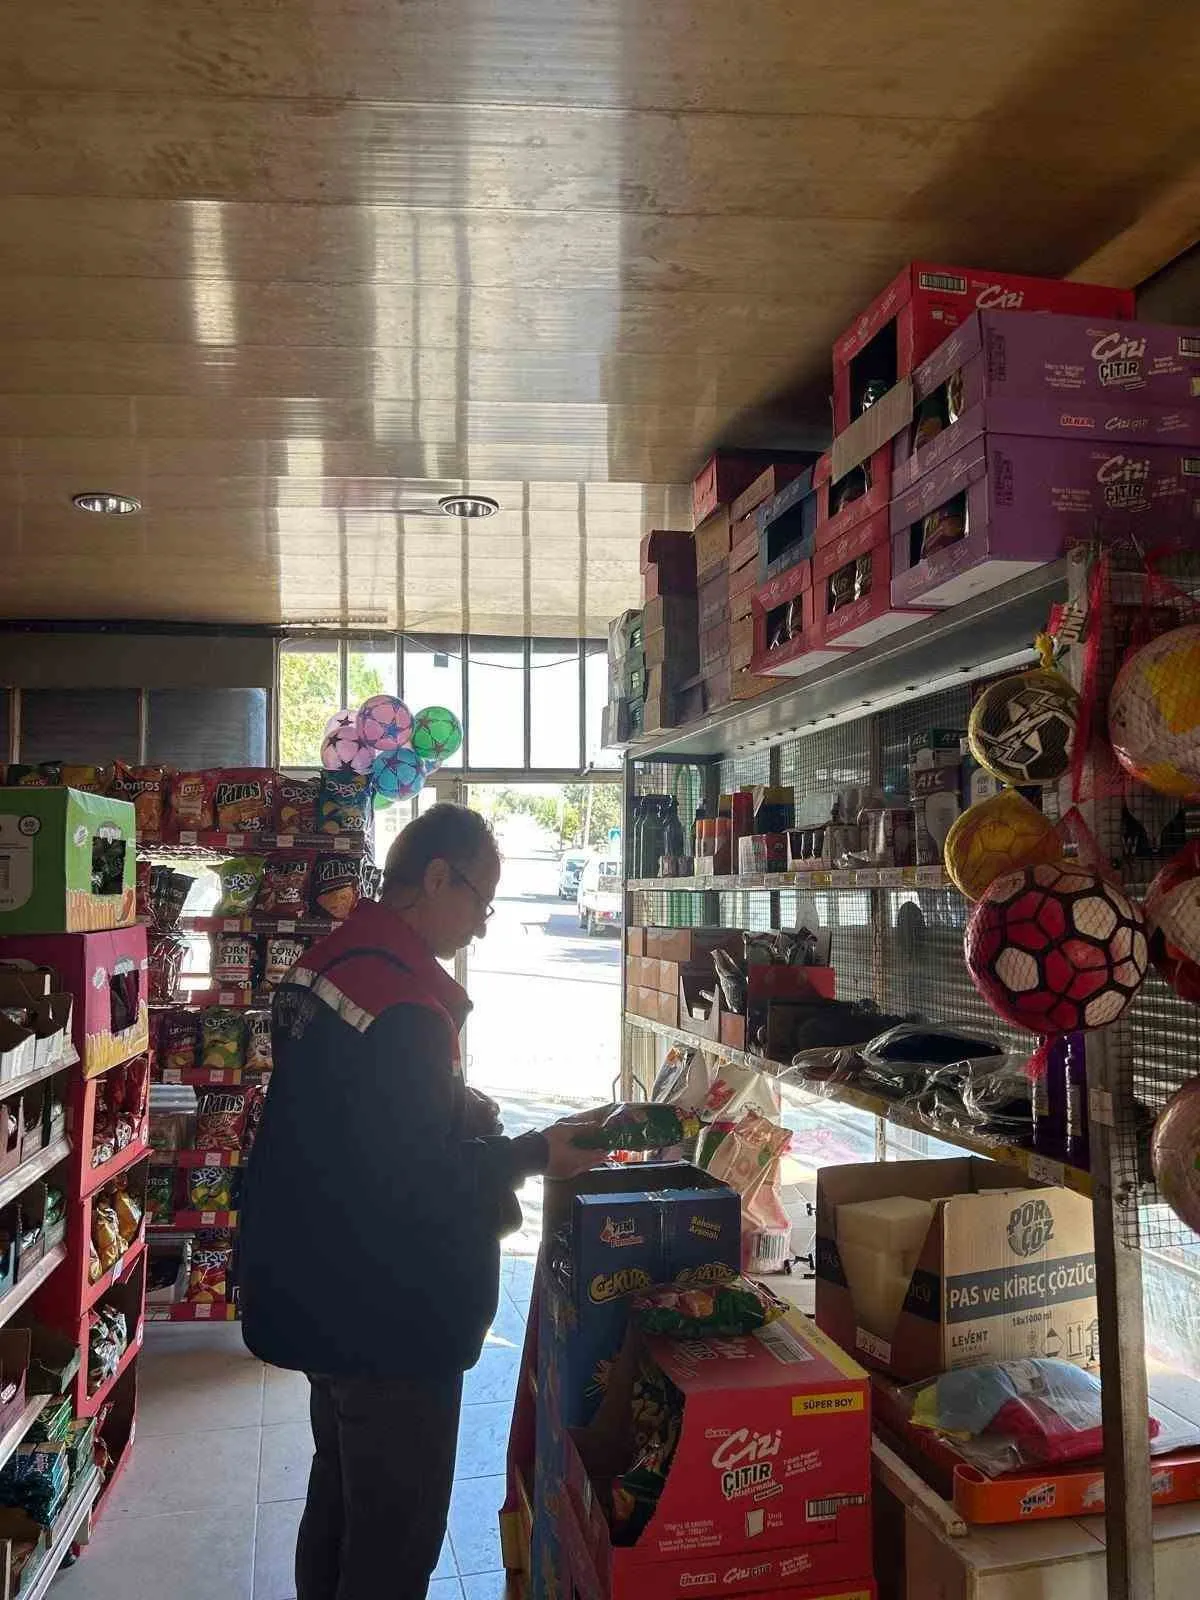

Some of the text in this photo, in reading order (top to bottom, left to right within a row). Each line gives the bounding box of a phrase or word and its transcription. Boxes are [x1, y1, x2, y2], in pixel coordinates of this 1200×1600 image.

[951, 1285, 979, 1308] PAS
[983, 1288, 1000, 1302] ve
[1004, 1273, 1046, 1300] KİREÇ
[834, 1396, 854, 1409] BOY
[723, 1463, 770, 1498] ÇITIR
